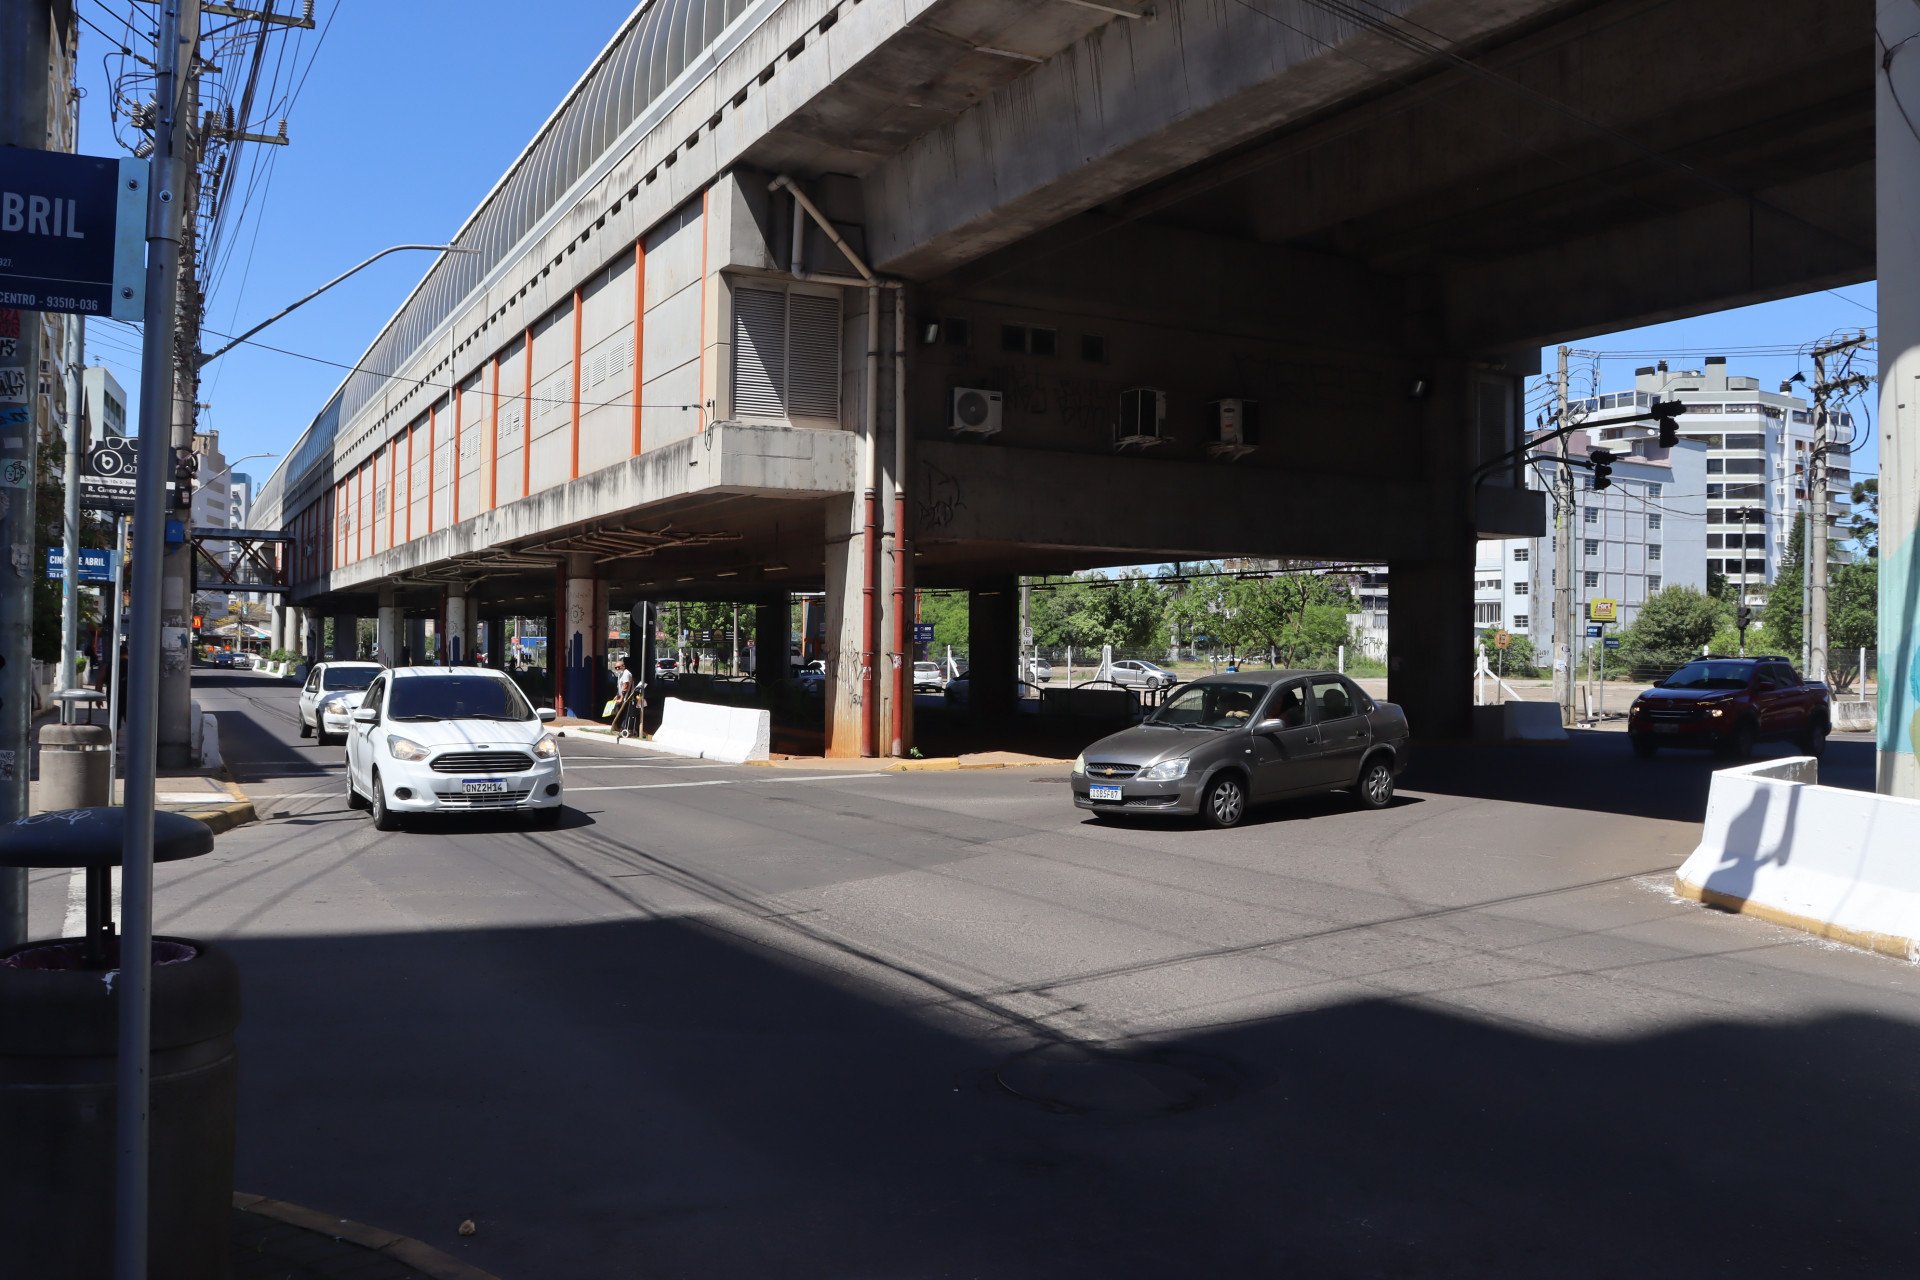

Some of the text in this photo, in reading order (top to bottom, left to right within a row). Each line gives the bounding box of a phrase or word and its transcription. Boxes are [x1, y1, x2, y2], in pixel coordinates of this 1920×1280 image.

[2, 192, 84, 239] BRIL
[0, 292, 35, 305] CENTRO
[47, 296, 98, 310] 93510-036
[85, 557, 105, 566] ABRIL
